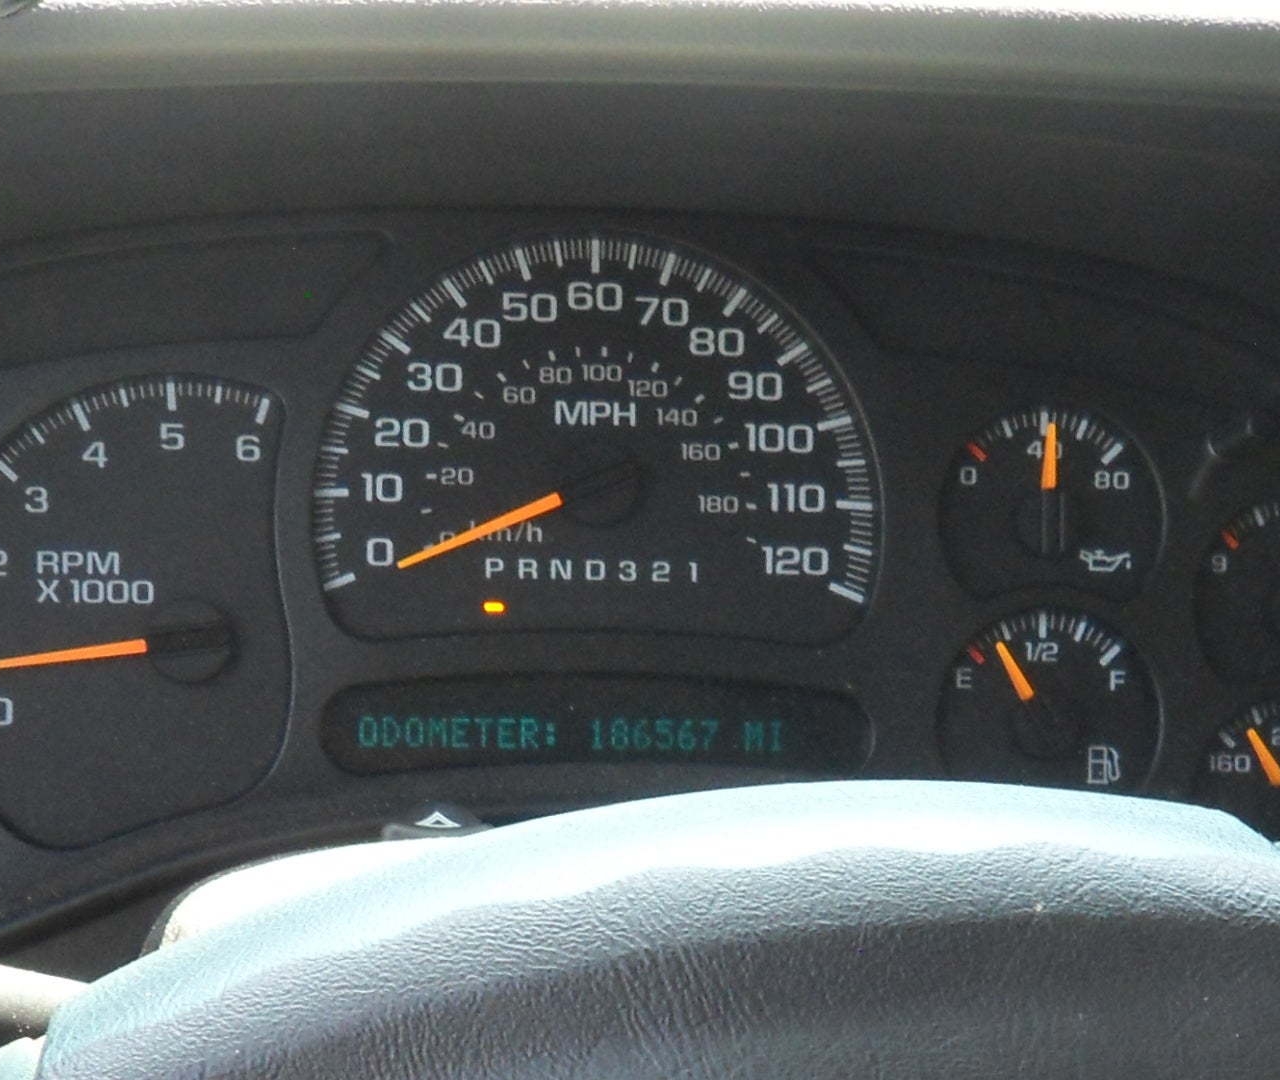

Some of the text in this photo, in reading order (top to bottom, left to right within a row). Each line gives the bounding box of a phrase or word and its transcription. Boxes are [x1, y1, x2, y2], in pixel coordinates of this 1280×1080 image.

[502, 293, 558, 322] 50
[567, 282, 623, 311] 60
[635, 297, 690, 327] 70
[443, 318, 502, 348] 40
[688, 328, 745, 356] 80
[406, 363, 463, 392] 30
[538, 366, 572, 385] 80
[581, 364, 622, 382] 100
[727, 371, 784, 401] 90
[502, 386, 536, 404] 60
[627, 380, 668, 398] 120
[554, 400, 637, 426] MPH
[656, 408, 697, 427] 140
[159, 423, 185, 451] 5
[374, 418, 429, 447] 20
[461, 422, 495, 440] 40
[744, 423, 815, 453] 100
[82, 441, 108, 468] 4
[235, 435, 261, 463] 6
[681, 443, 720, 461] 160
[361, 473, 403, 502] 10
[440, 468, 474, 486] 20
[959, 468, 978, 486] 0
[1093, 471, 1131, 490] 80
[24, 486, 49, 513] 3
[698, 495, 738, 514] 180
[767, 483, 825, 513] 110
[36, 551, 120, 575] RPM
[365, 537, 394, 567] 0
[762, 546, 829, 576] 120
[1211, 555, 1228, 573] 9
[36, 580, 155, 605] X 1000
[1025, 642, 1059, 662] 1/2
[955, 668, 972, 689] E
[1109, 670, 1126, 691] F
[358, 716, 783, 752] ODOMETER: 186567 MI
[1209, 755, 1251, 773] 160
